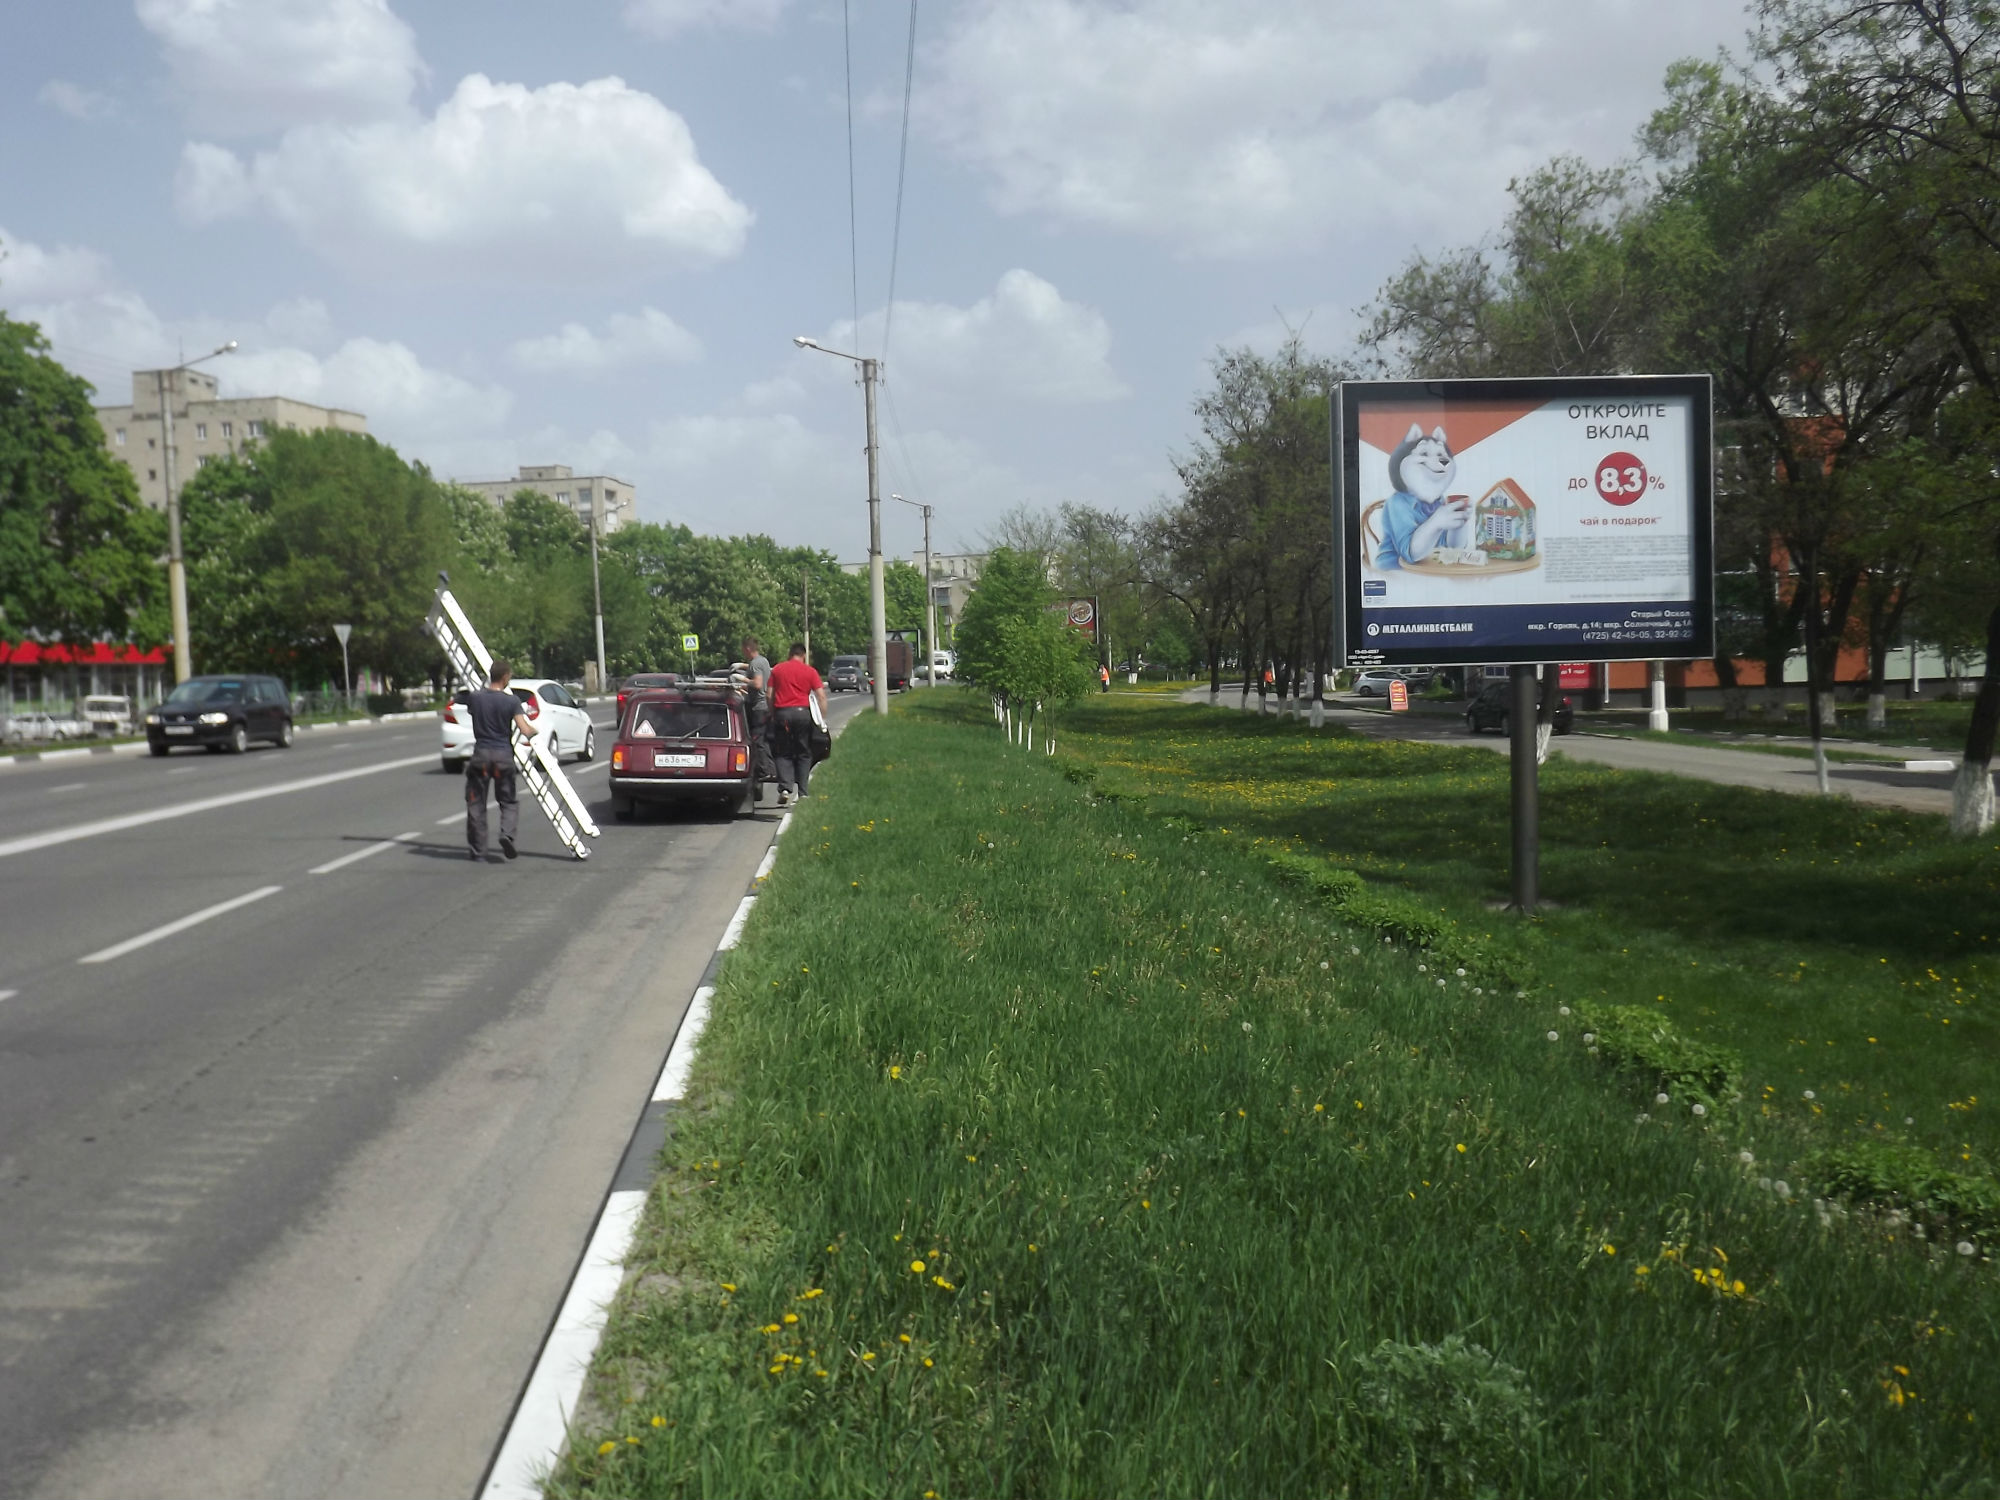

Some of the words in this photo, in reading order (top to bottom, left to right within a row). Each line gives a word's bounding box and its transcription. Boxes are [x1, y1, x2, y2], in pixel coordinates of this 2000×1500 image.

[1568, 401, 1666, 419] ОТКРОЙТЕ
[1586, 424, 1649, 441] ВКЛАД
[1568, 478, 1588, 490] ДО
[1579, 517, 1599, 526] чай
[1602, 518, 1609, 526] в
[1382, 623, 1474, 634] МЕТАЛЛИНВЕСТБАНК
[1583, 631, 1609, 641] (4725)
